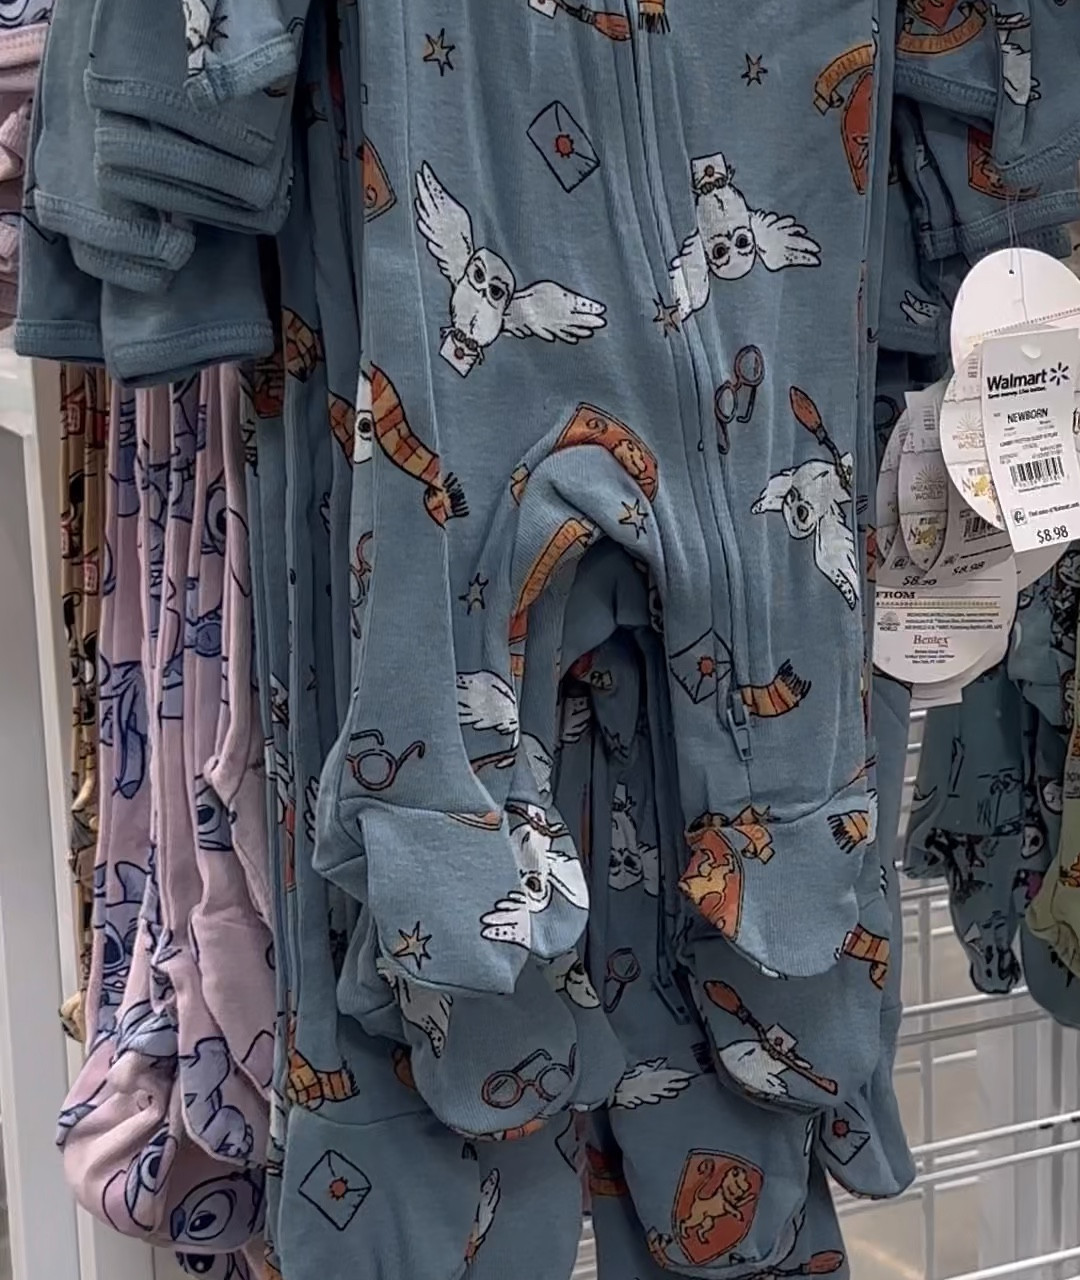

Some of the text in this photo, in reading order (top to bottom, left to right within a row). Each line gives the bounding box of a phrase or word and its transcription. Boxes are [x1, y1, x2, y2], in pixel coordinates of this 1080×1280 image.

[986, 368, 1048, 392] Walmart
[1007, 407, 1049, 424] NEWBORN
[1036, 524, 1069, 545] $8.98
